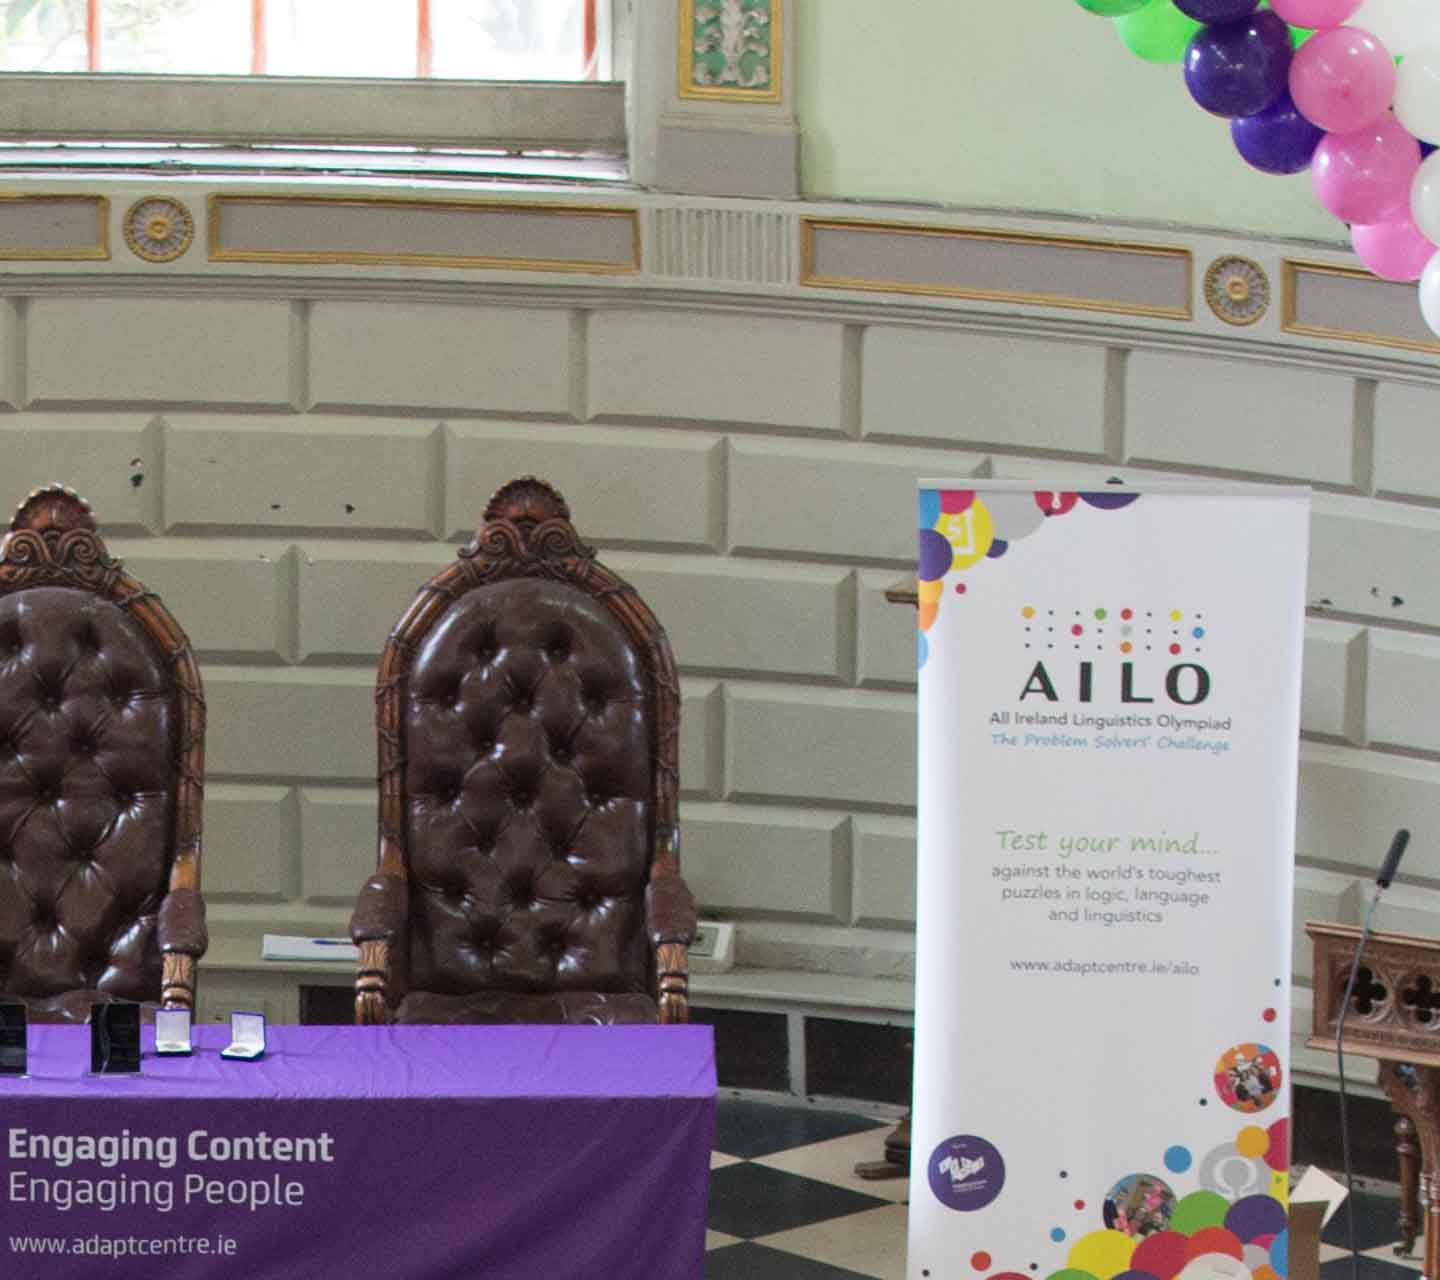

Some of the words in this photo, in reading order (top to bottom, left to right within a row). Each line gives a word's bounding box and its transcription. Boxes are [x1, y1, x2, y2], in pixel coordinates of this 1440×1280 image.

[1018, 660, 1211, 705] AILO
[989, 711, 1010, 725] All
[1014, 712, 1068, 726] Ireland
[1073, 712, 1152, 731] Linguistics
[1156, 714, 1232, 732] Olympiad
[991, 732, 1017, 746] The
[1024, 732, 1088, 748] Problem
[1156, 736, 1232, 754] Challenge
[996, 829, 1049, 851] Test
[1056, 835, 1121, 858] your
[1129, 829, 1220, 855] mind...
[992, 864, 1050, 882] against
[1055, 864, 1081, 879] the
[1086, 864, 1144, 880] world's
[1149, 866, 1222, 886] toughest
[1000, 885, 1061, 901] puzzles
[1066, 886, 1081, 899] in
[1085, 886, 1129, 904] logic,
[1134, 888, 1210, 907] language
[1048, 907, 1079, 921] and
[1084, 908, 1163, 926] linguistics
[1009, 957, 1201, 977] www.adaptcentre.ie/ailo
[8, 1128, 177, 1167] Engaging
[187, 1130, 334, 1162] Content
[8, 1171, 174, 1211] Engaging
[185, 1174, 305, 1211] People
[9, 1234, 238, 1258] www.adaptcentre.ie
